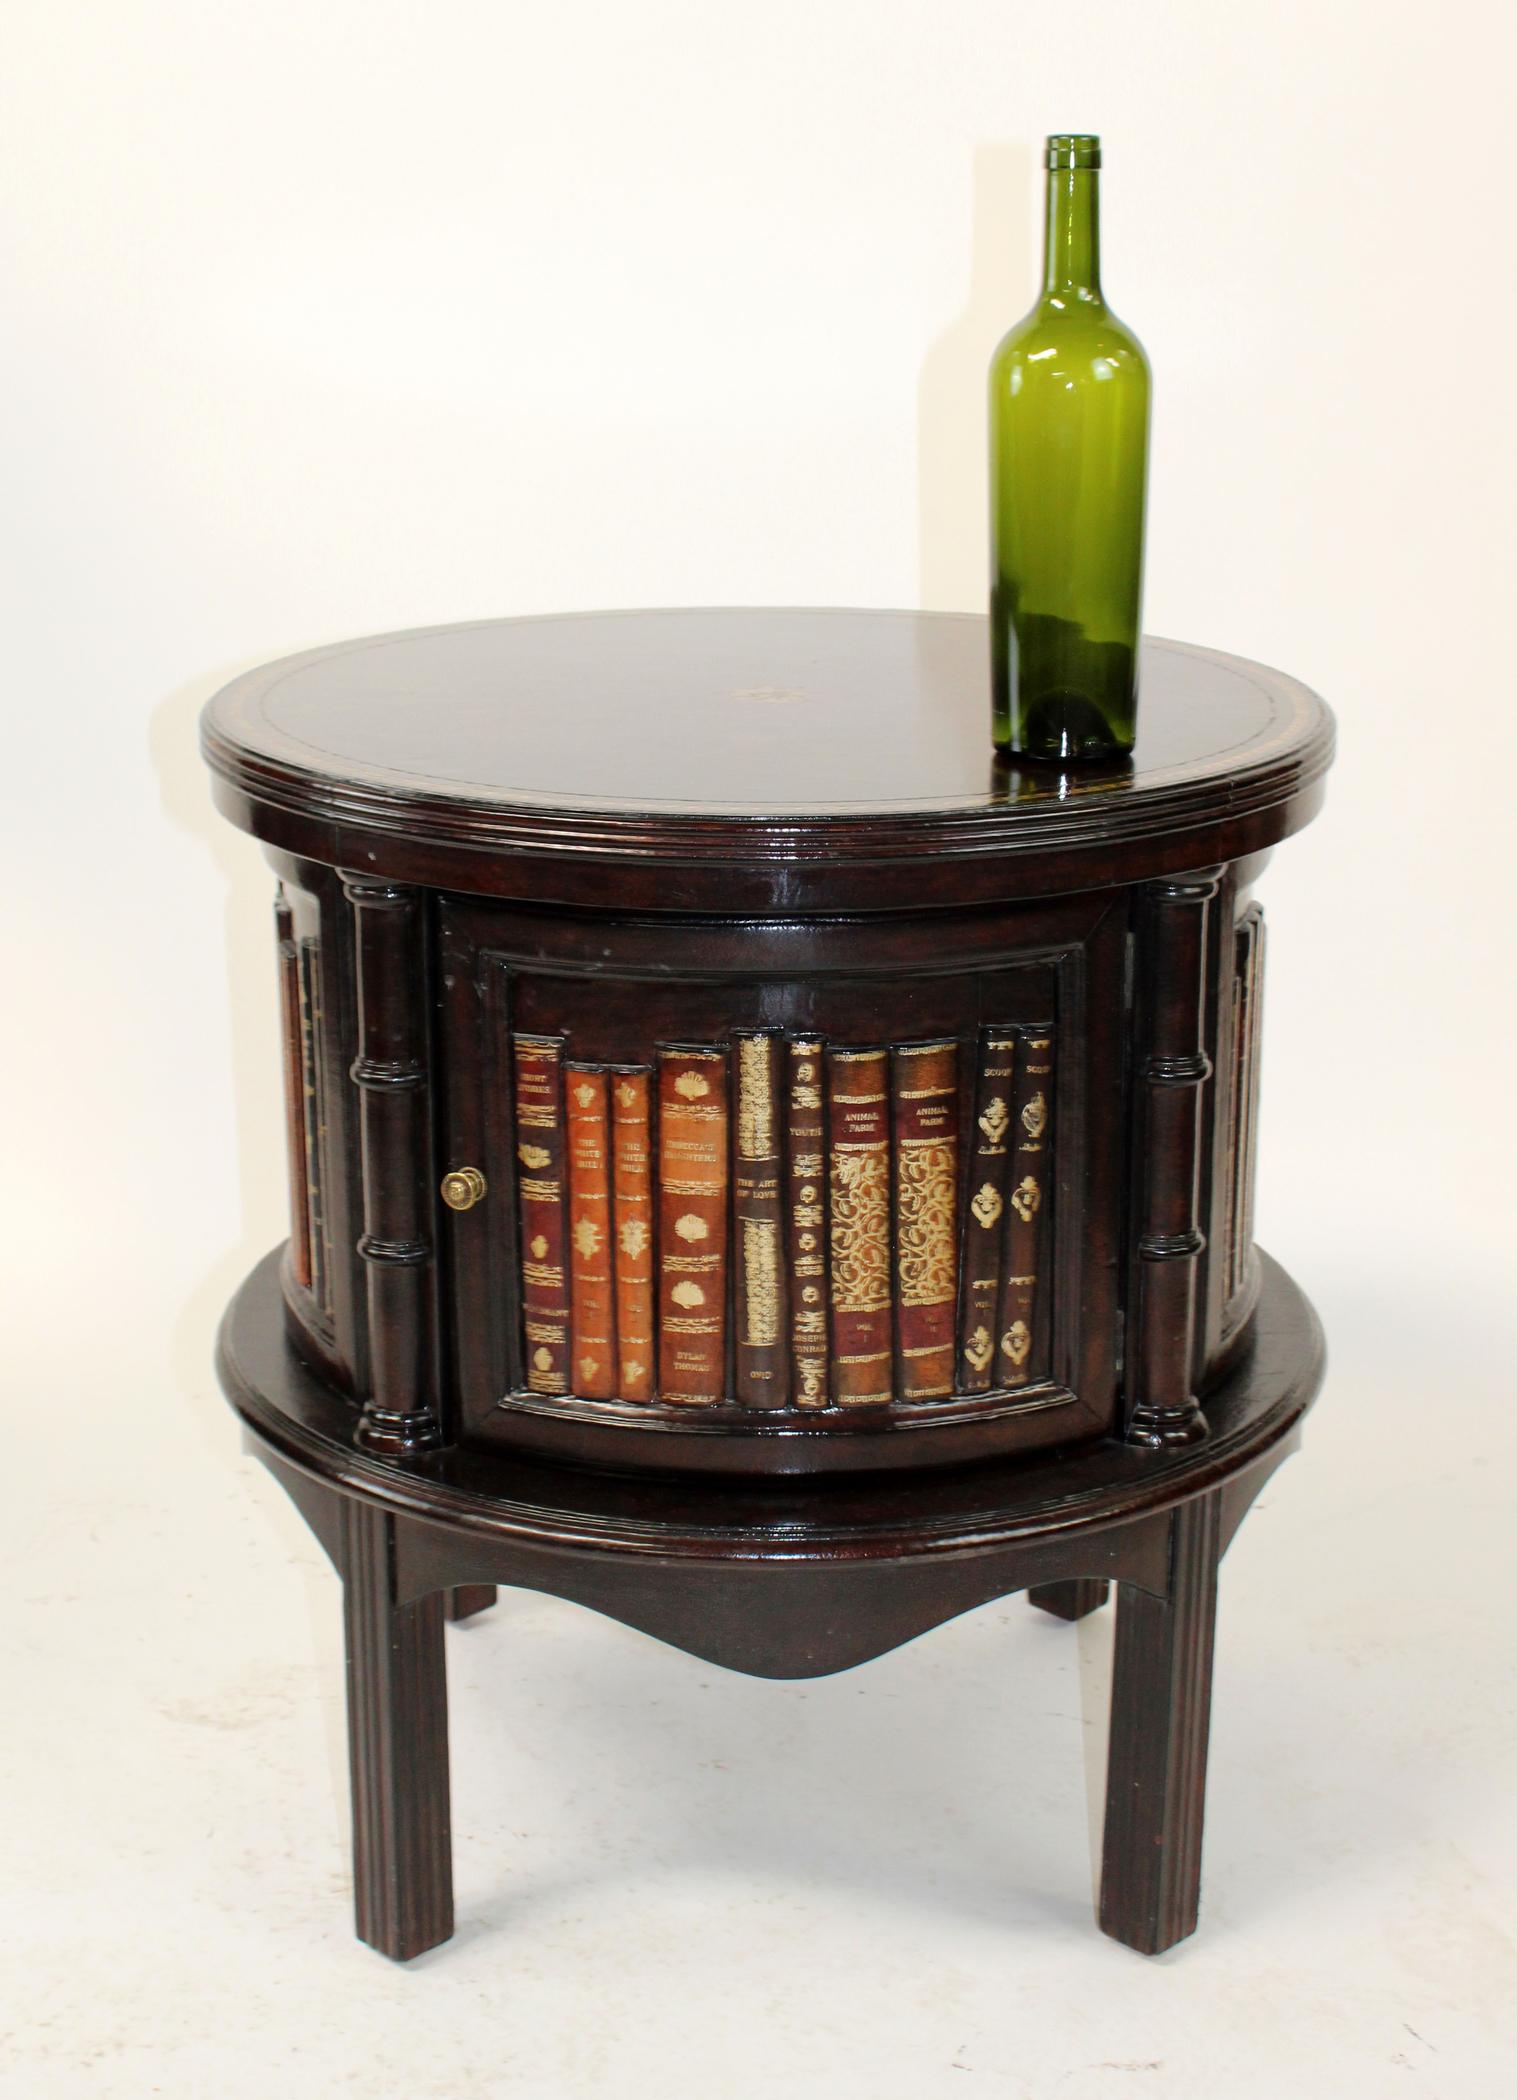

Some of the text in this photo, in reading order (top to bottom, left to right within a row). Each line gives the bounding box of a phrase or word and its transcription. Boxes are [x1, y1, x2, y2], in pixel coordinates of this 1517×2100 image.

[916, 1106, 949, 1116] ANIMAL
[844, 1112, 879, 1122] ANIMAL
[920, 1117, 945, 1127] FARM
[789, 1127, 823, 1137] YOUTH
[848, 1123, 875, 1133] FARM
[737, 1178, 778, 1188] THE ART
[736, 1189, 777, 1200] OF LOVE
[792, 1334, 827, 1343] JOSEPH
[792, 1345, 827, 1354] CONRAD
[676, 1351, 706, 1361] DYLAN
[673, 1361, 711, 1372] THOMAS
